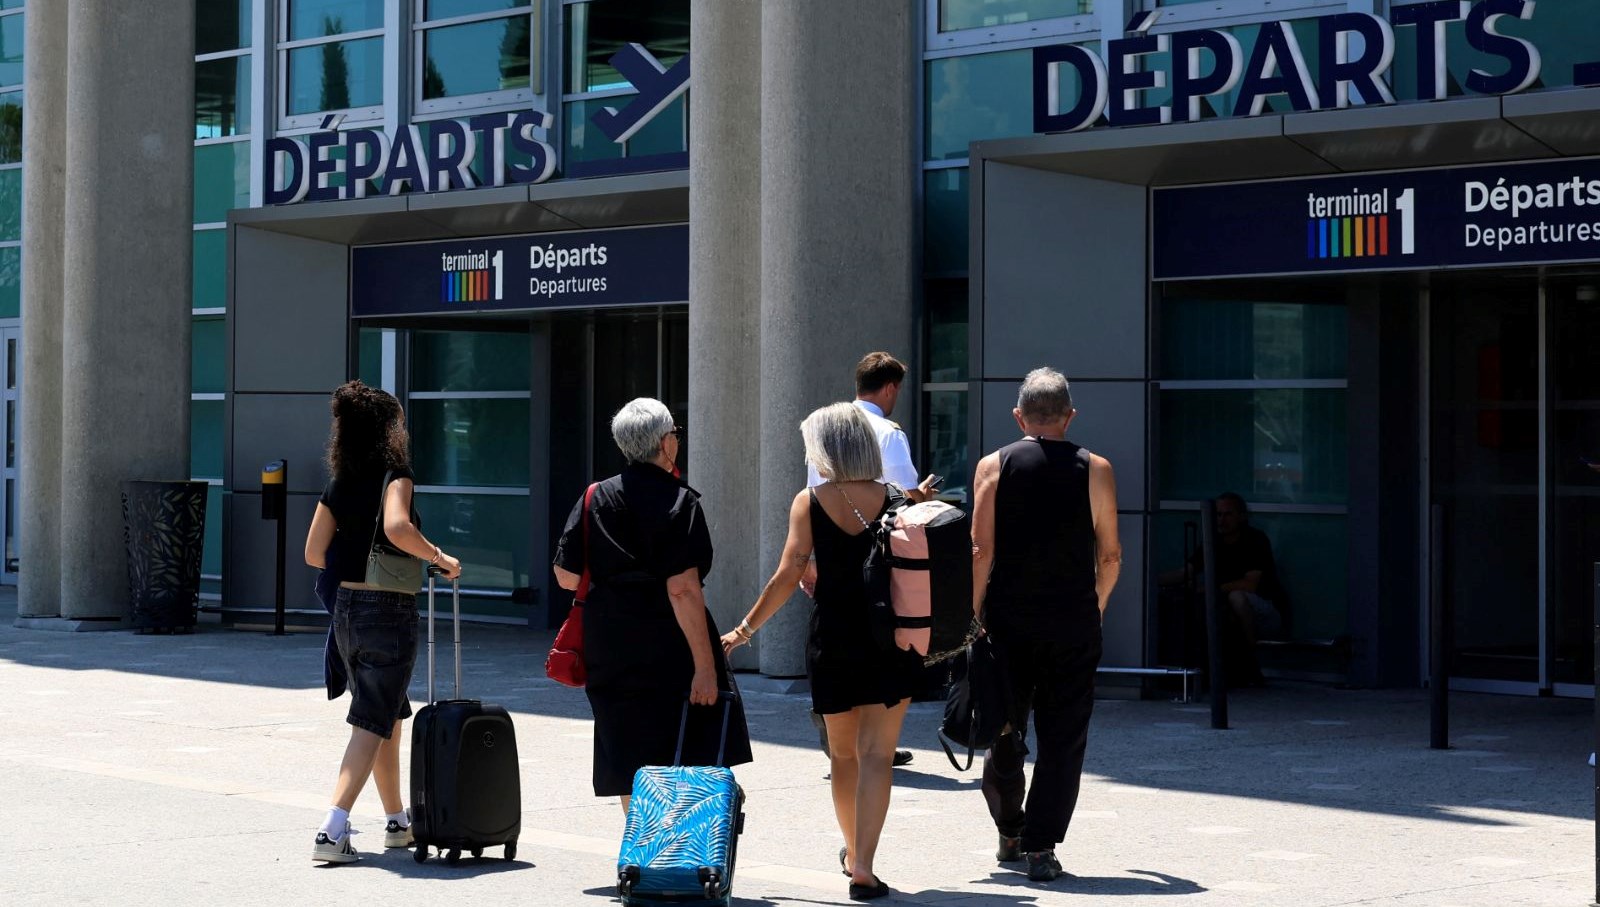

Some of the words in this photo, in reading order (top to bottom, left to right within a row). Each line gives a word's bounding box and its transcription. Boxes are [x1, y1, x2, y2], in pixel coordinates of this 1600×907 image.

[1033, 0, 1542, 134] DÉPARTS
[265, 109, 557, 205] DÉPARTS
[1307, 187, 1388, 218] terminal
[1396, 188, 1415, 254] 1
[1465, 177, 1600, 218] Départs
[530, 242, 607, 273] Départs
[1465, 221, 1600, 251] Departures
[442, 249, 488, 272] terminal
[492, 250, 503, 300] 1
[530, 276, 607, 299] Departures
